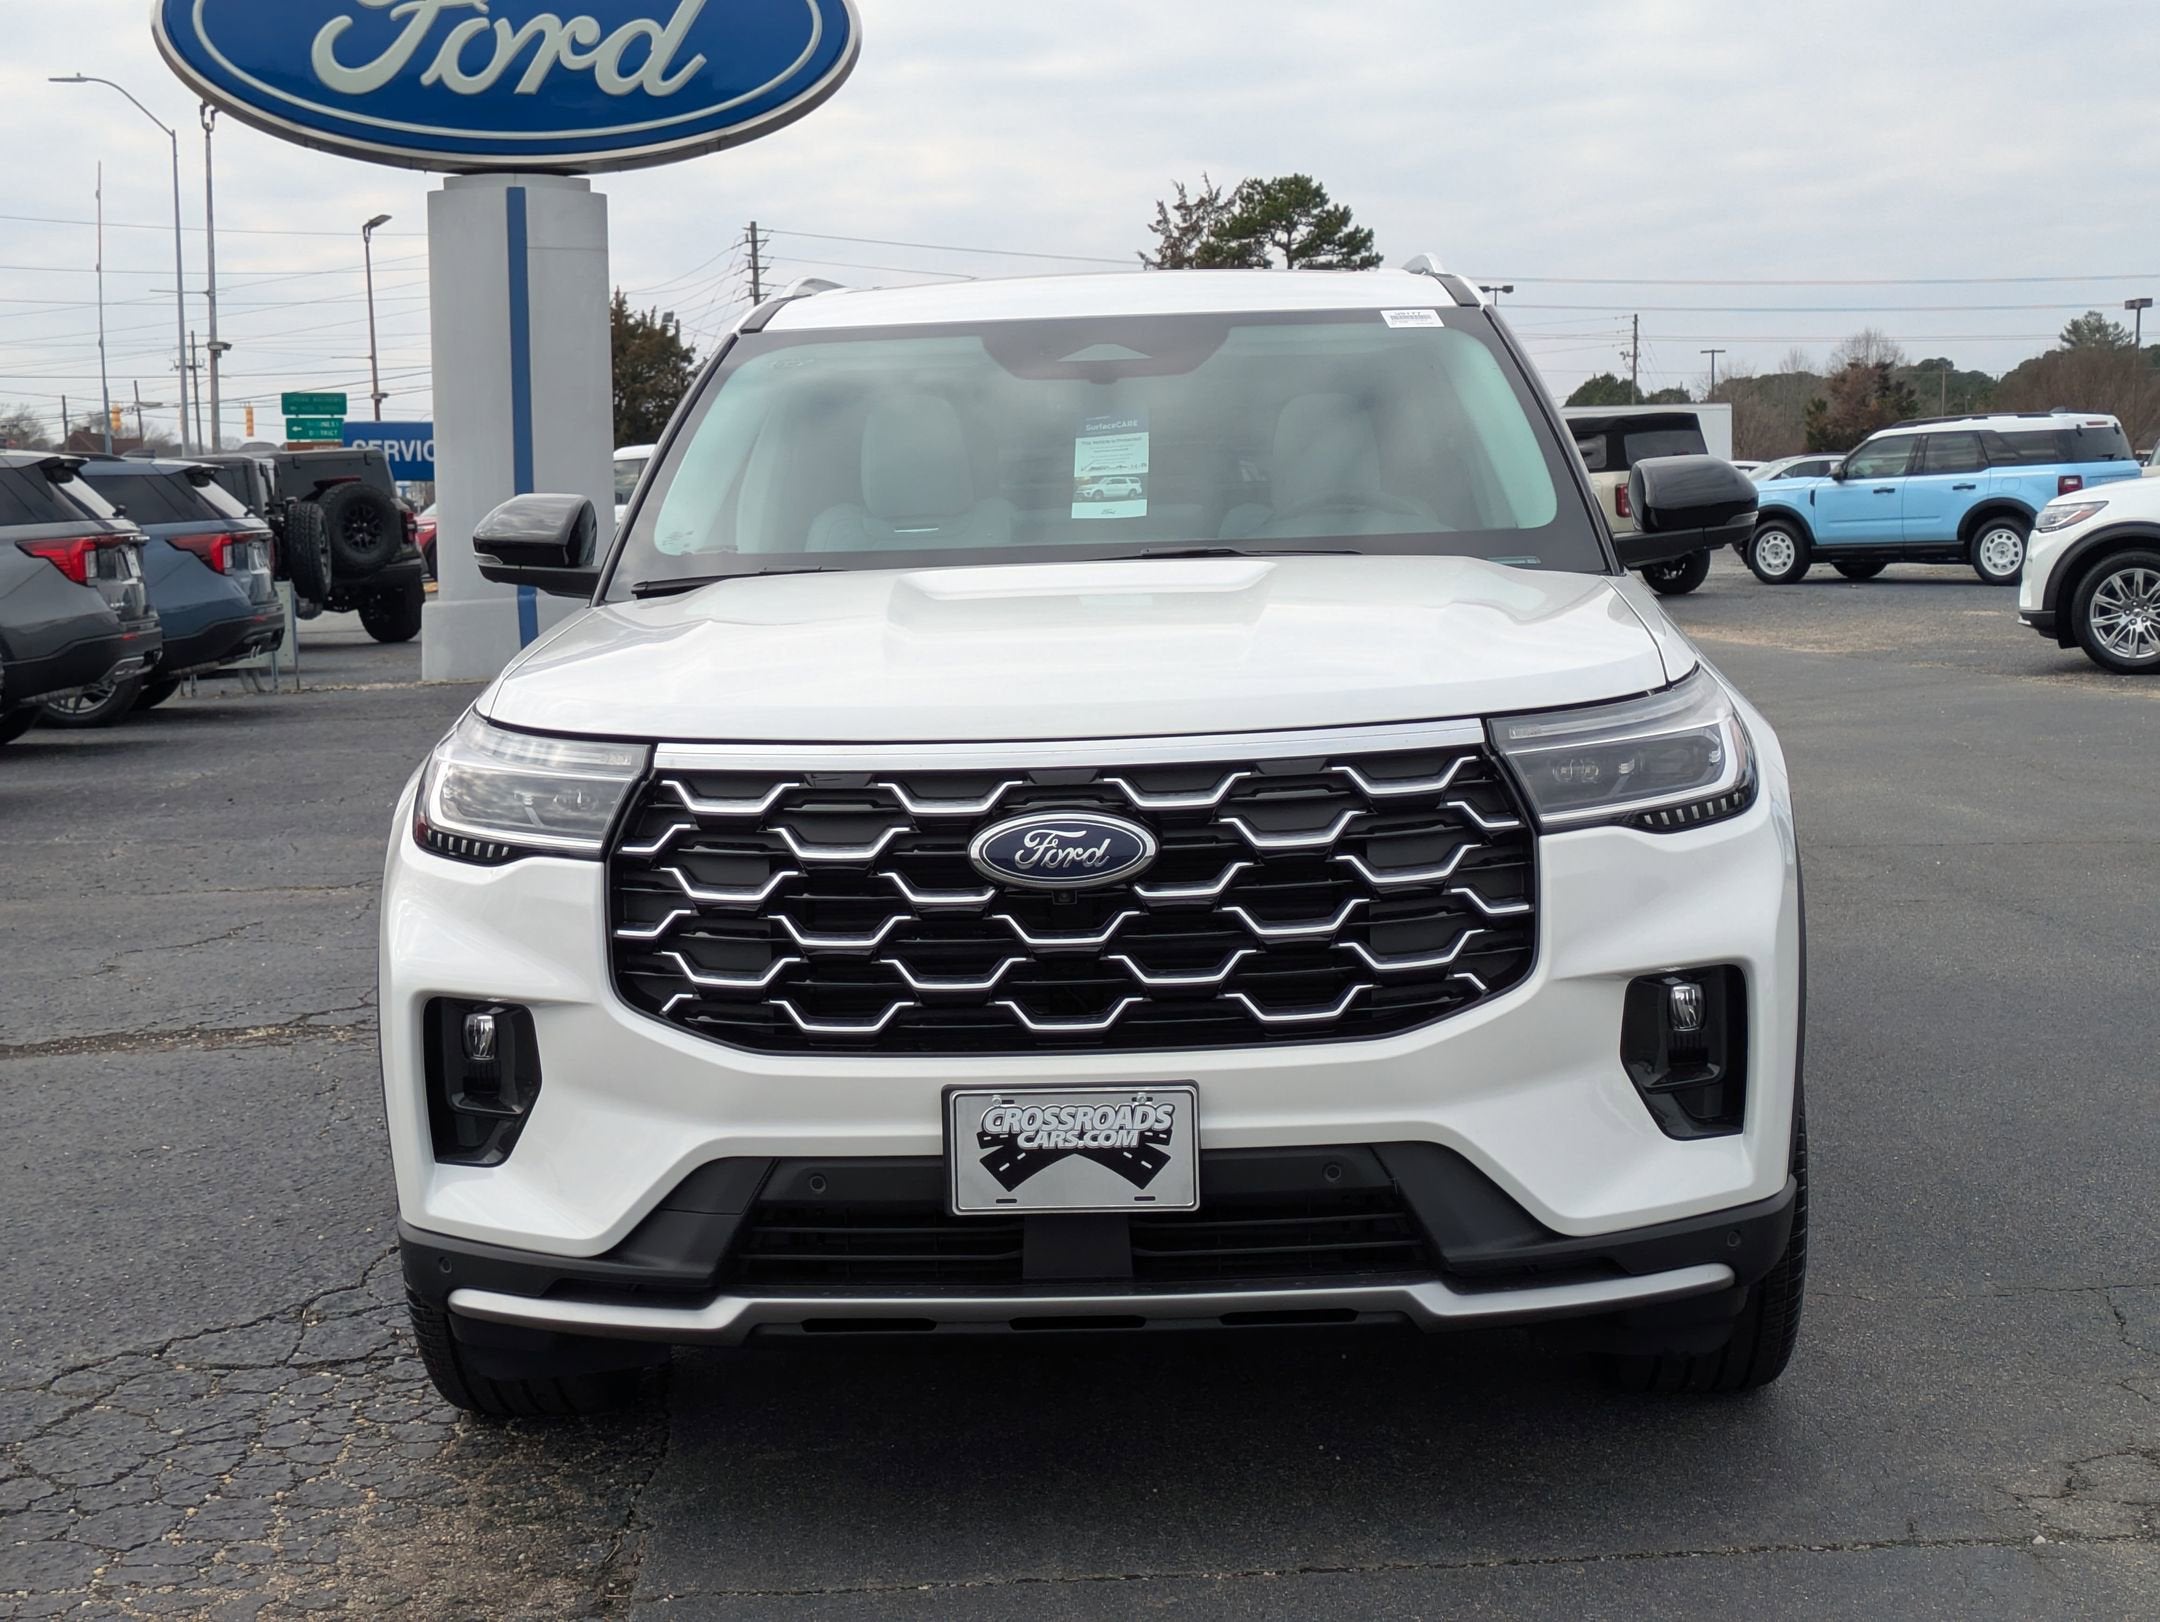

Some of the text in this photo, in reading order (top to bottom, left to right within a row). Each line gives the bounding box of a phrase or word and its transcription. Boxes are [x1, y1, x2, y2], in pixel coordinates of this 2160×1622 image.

[311, 0, 707, 97] Ford
[1014, 829, 1110, 870] Ford
[983, 1103, 1175, 1134] CROSSROADS
[1017, 1129, 1140, 1149] CARS.COM
